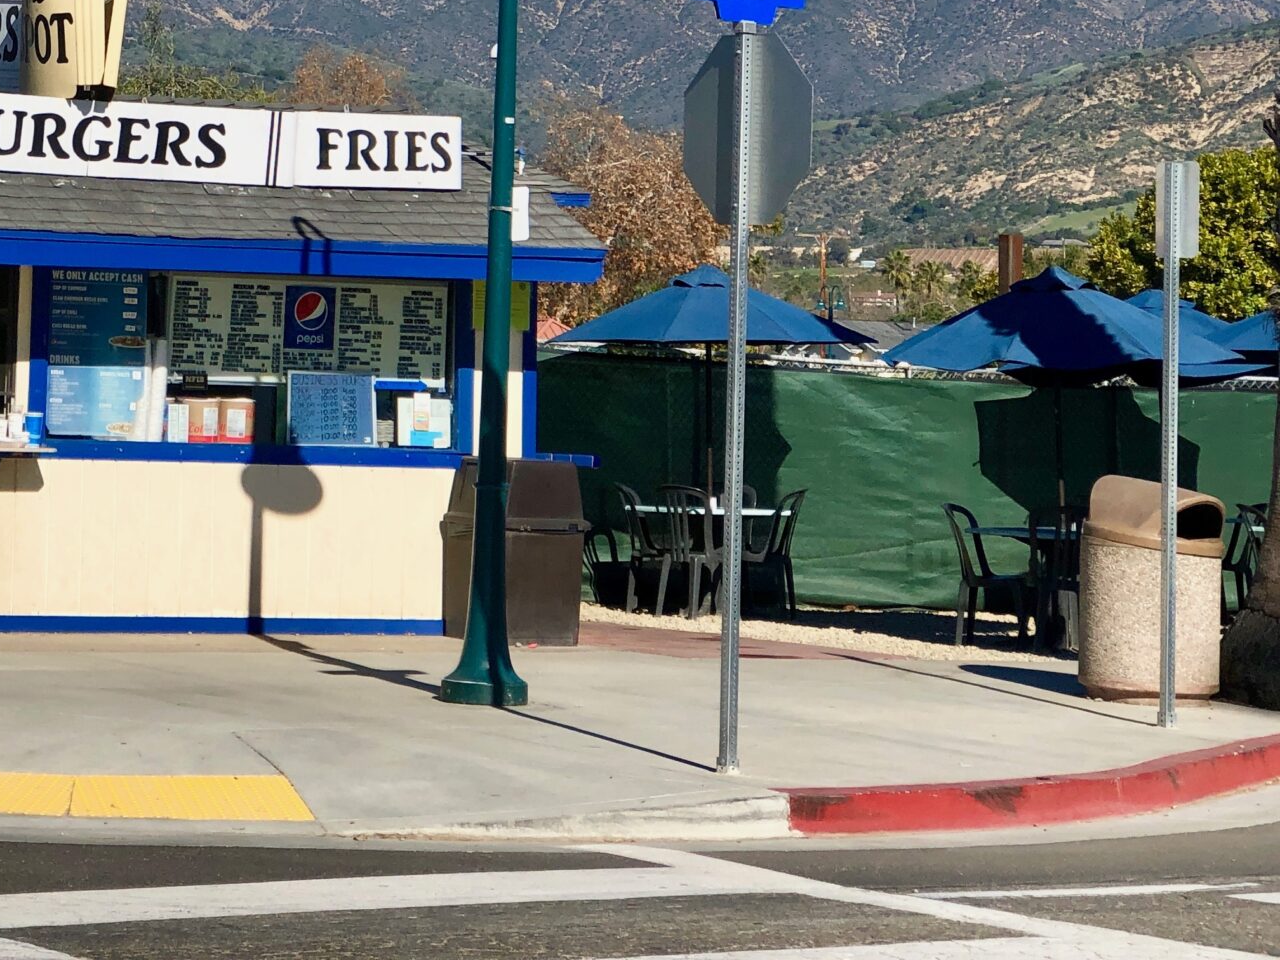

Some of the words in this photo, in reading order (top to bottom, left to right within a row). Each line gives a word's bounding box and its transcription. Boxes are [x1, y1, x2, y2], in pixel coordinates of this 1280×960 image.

[318, 127, 452, 174] FRIES
[52, 270, 64, 279] WE
[66, 270, 87, 280] ONLY
[88, 271, 119, 282] ACCEPT
[121, 273, 143, 283] CASH
[296, 333, 324, 345] pepsi
[49, 354, 80, 365] DRINKS
